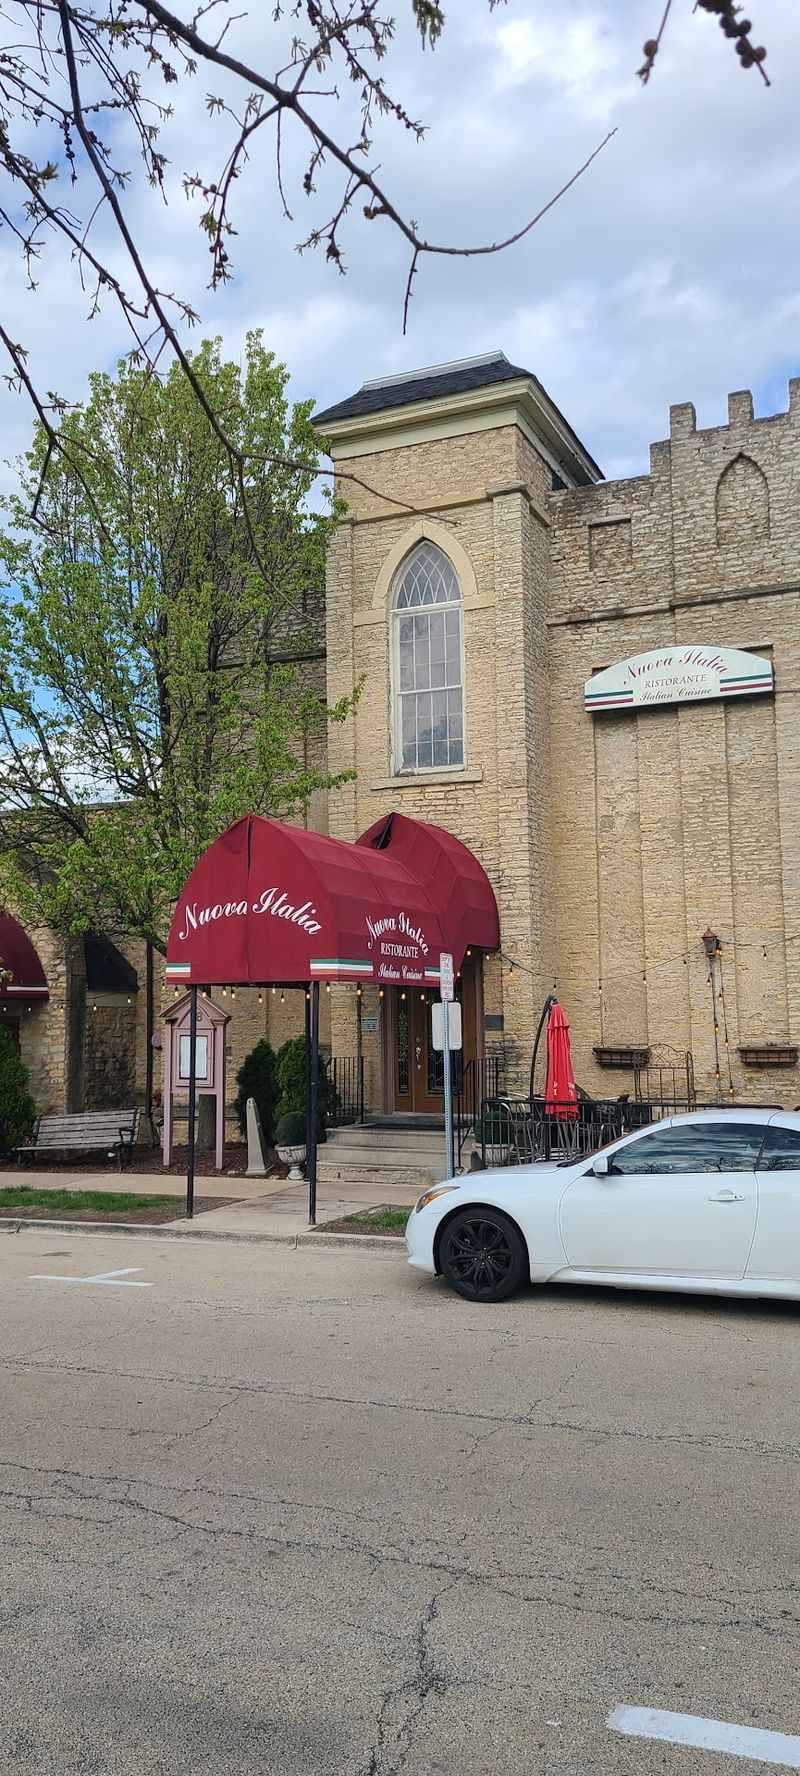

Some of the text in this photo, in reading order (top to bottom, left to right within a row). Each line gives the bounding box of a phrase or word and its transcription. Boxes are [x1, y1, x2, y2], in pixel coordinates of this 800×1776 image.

[623, 649, 728, 685] Nuova Italia
[640, 687, 712, 702] Italian Cuisine
[644, 674, 708, 689] RISTORANTE
[178, 887, 322, 940] Nuova Italia
[365, 912, 429, 956] Nuova Italia
[380, 942, 419, 959] RISTORANTE
